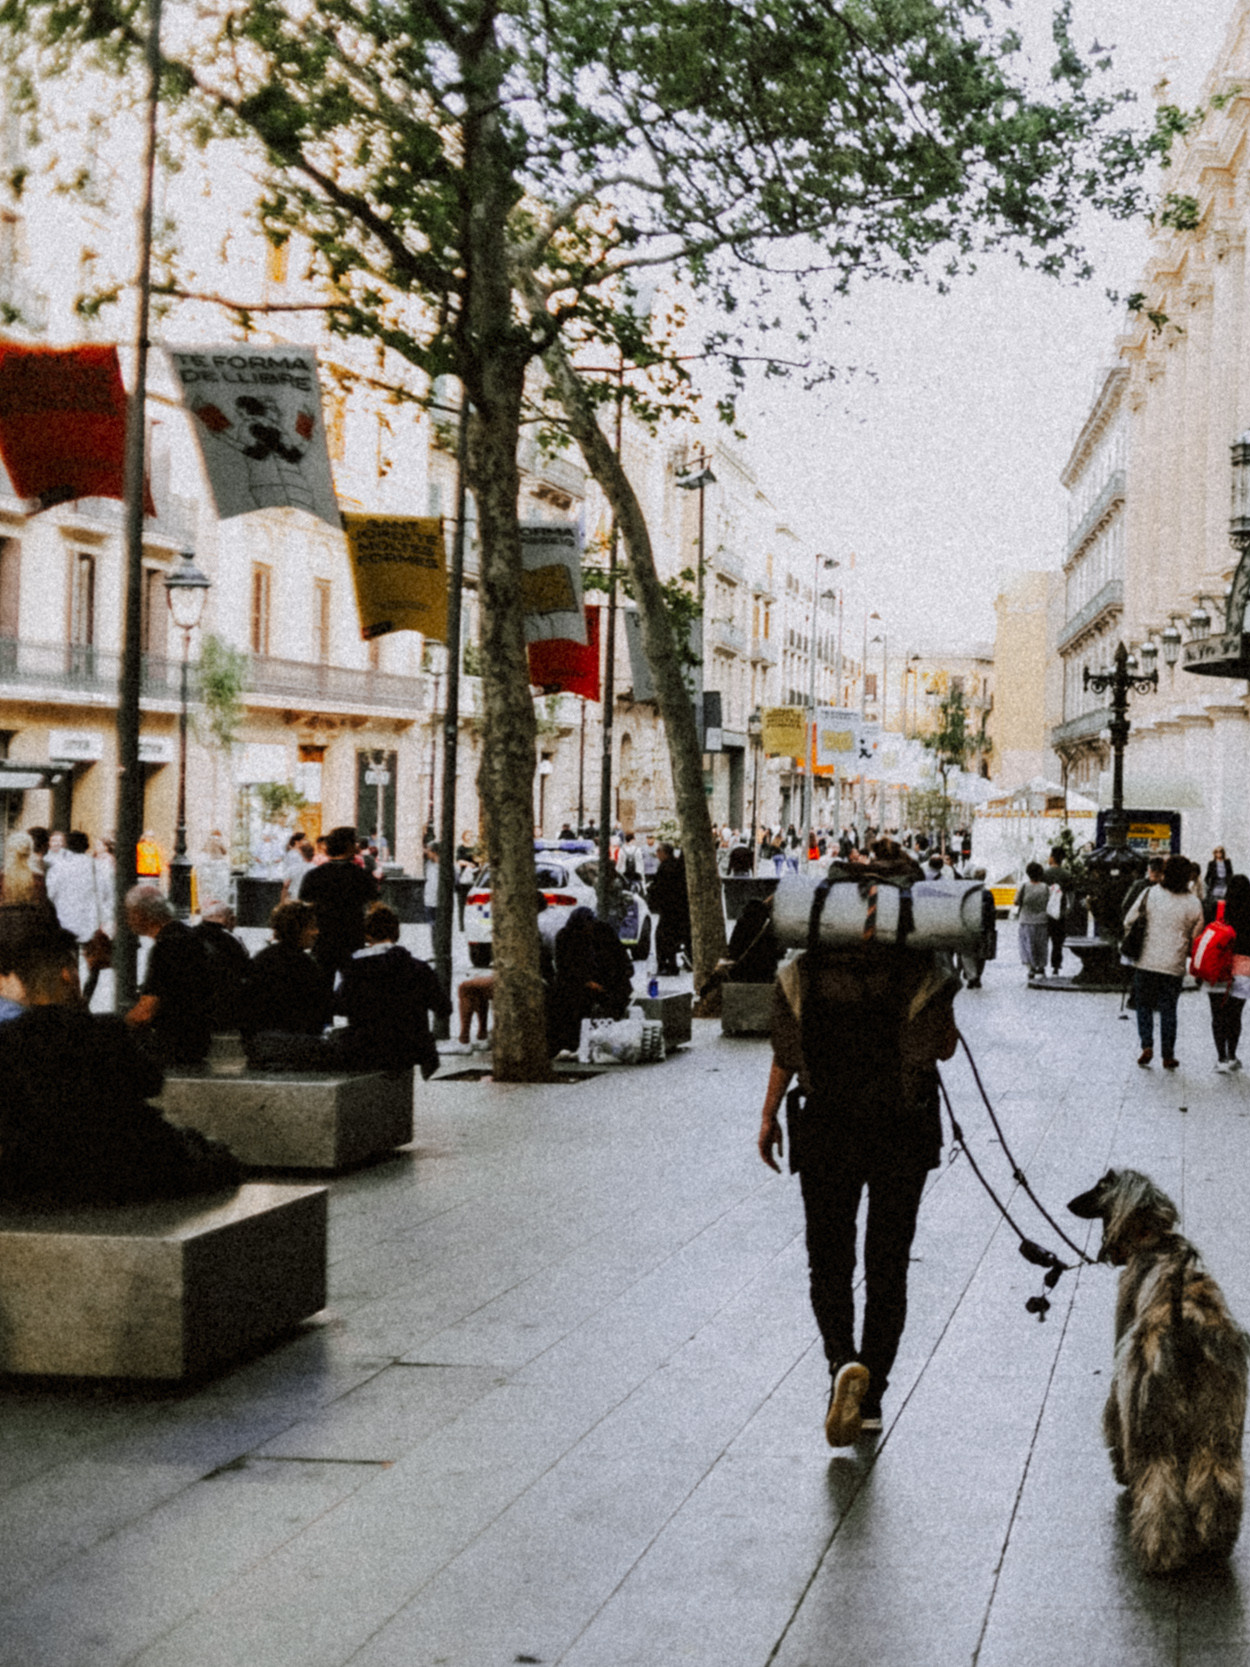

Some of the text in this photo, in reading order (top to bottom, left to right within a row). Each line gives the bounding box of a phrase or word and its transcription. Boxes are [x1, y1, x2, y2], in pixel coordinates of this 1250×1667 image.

[211, 355, 310, 373] FORMA
[180, 369, 312, 392] DE LLIBRE
[518, 527, 575, 538] ORMA
